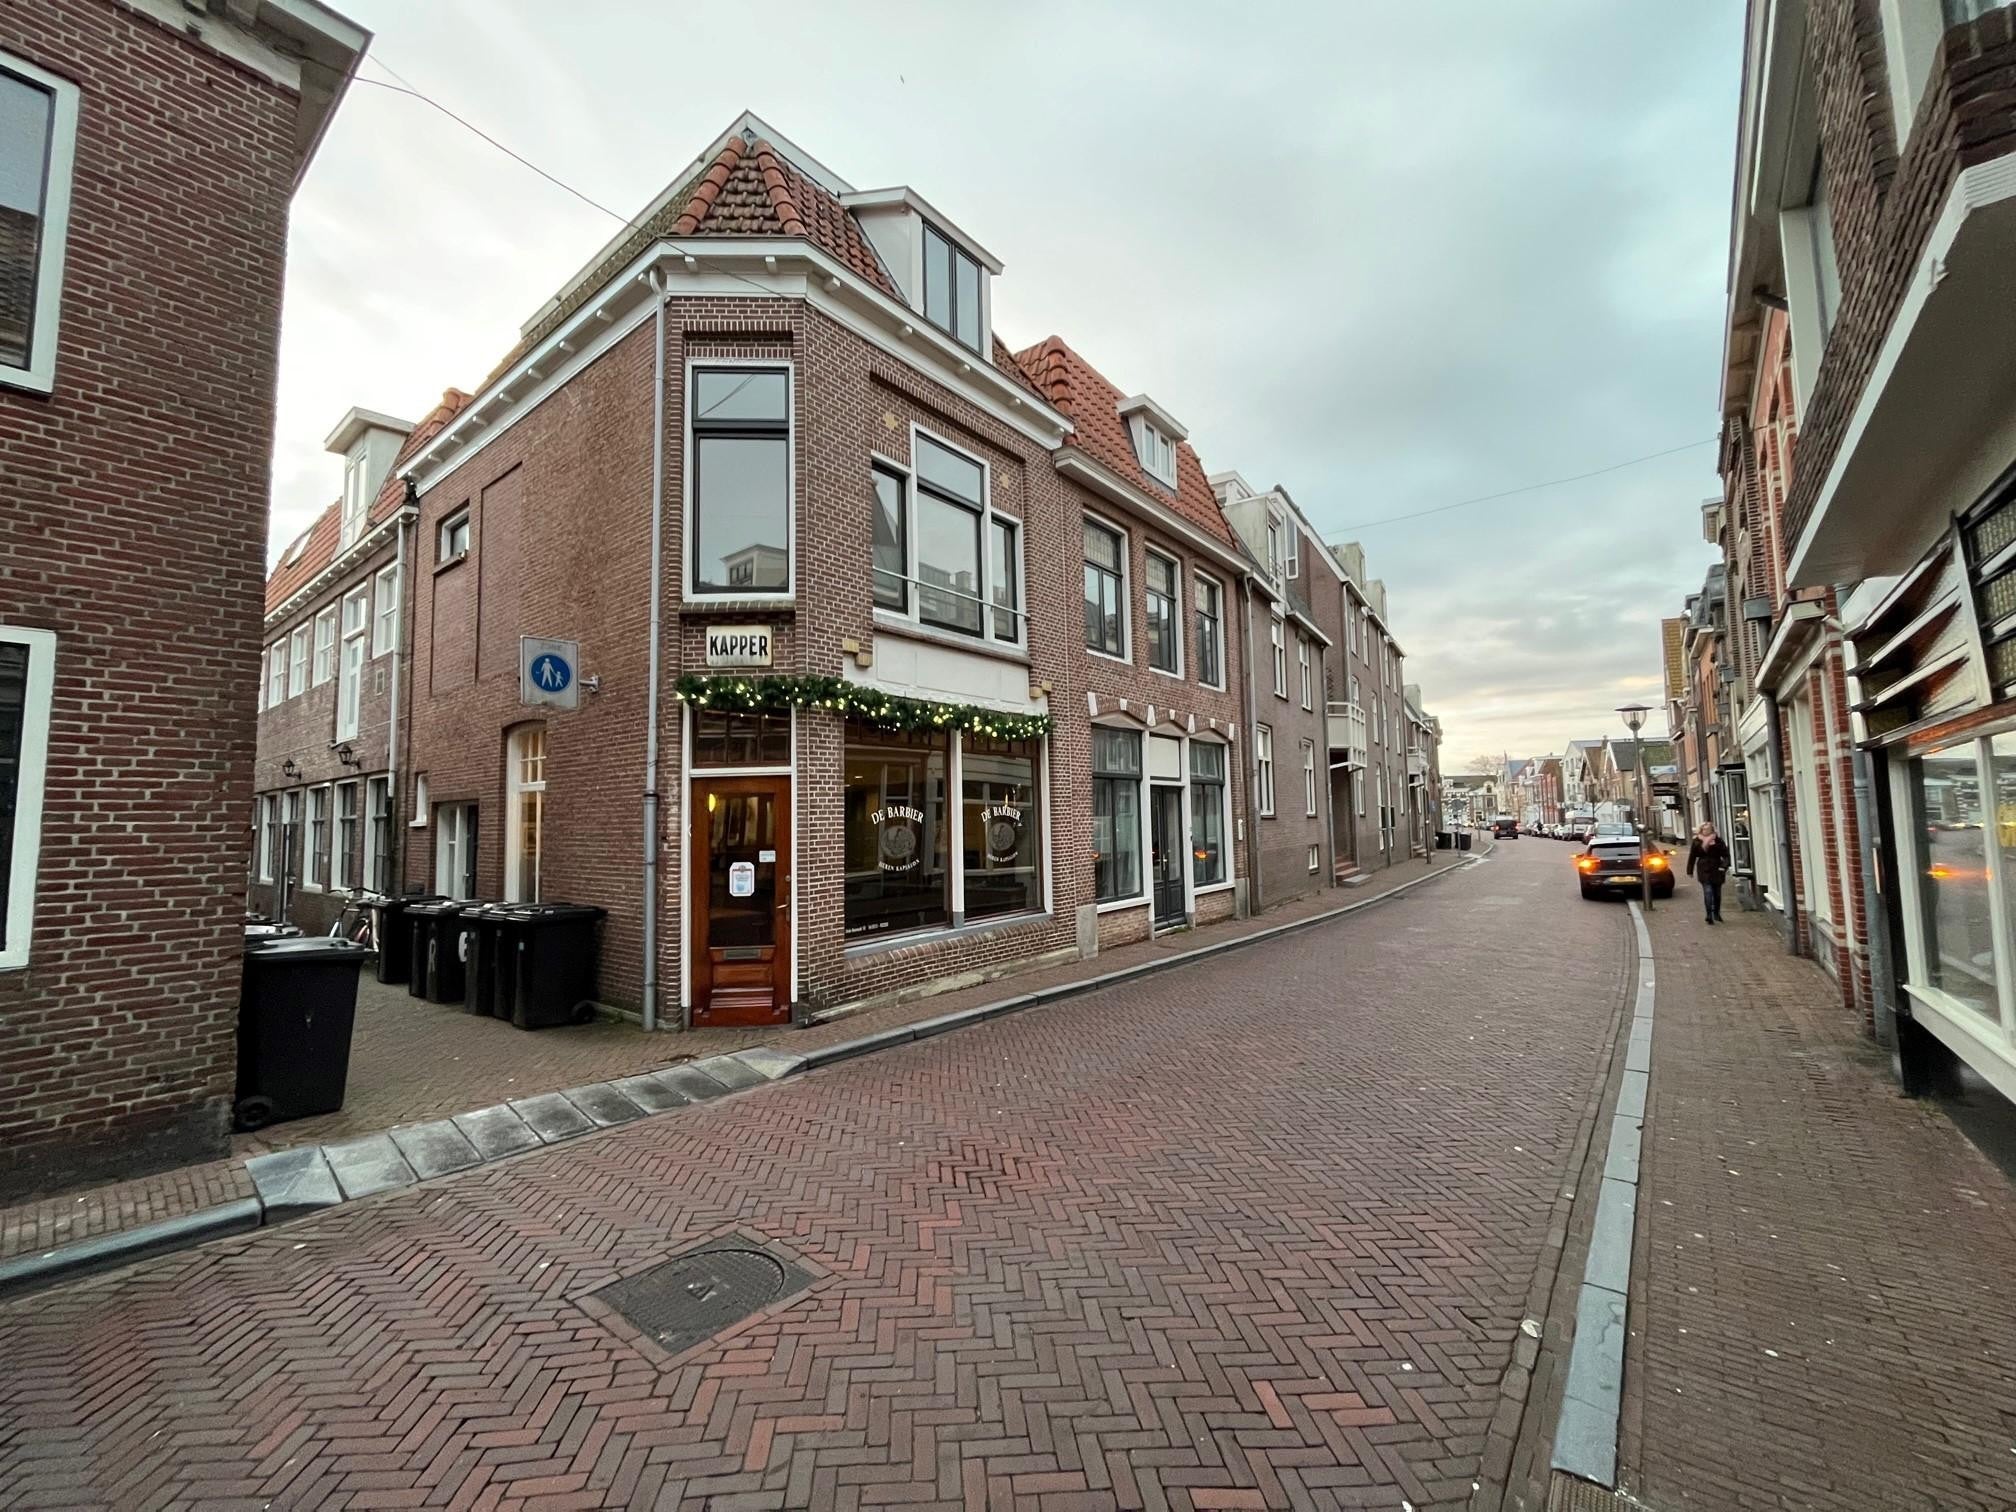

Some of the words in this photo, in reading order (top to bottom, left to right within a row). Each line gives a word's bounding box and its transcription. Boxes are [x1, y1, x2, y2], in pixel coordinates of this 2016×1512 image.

[709, 635, 768, 656] KAPPER
[871, 809, 885, 825] DE
[887, 805, 924, 824] BARBIER
[981, 808, 992, 822] DE
[993, 806, 1021, 821] BARBIER
